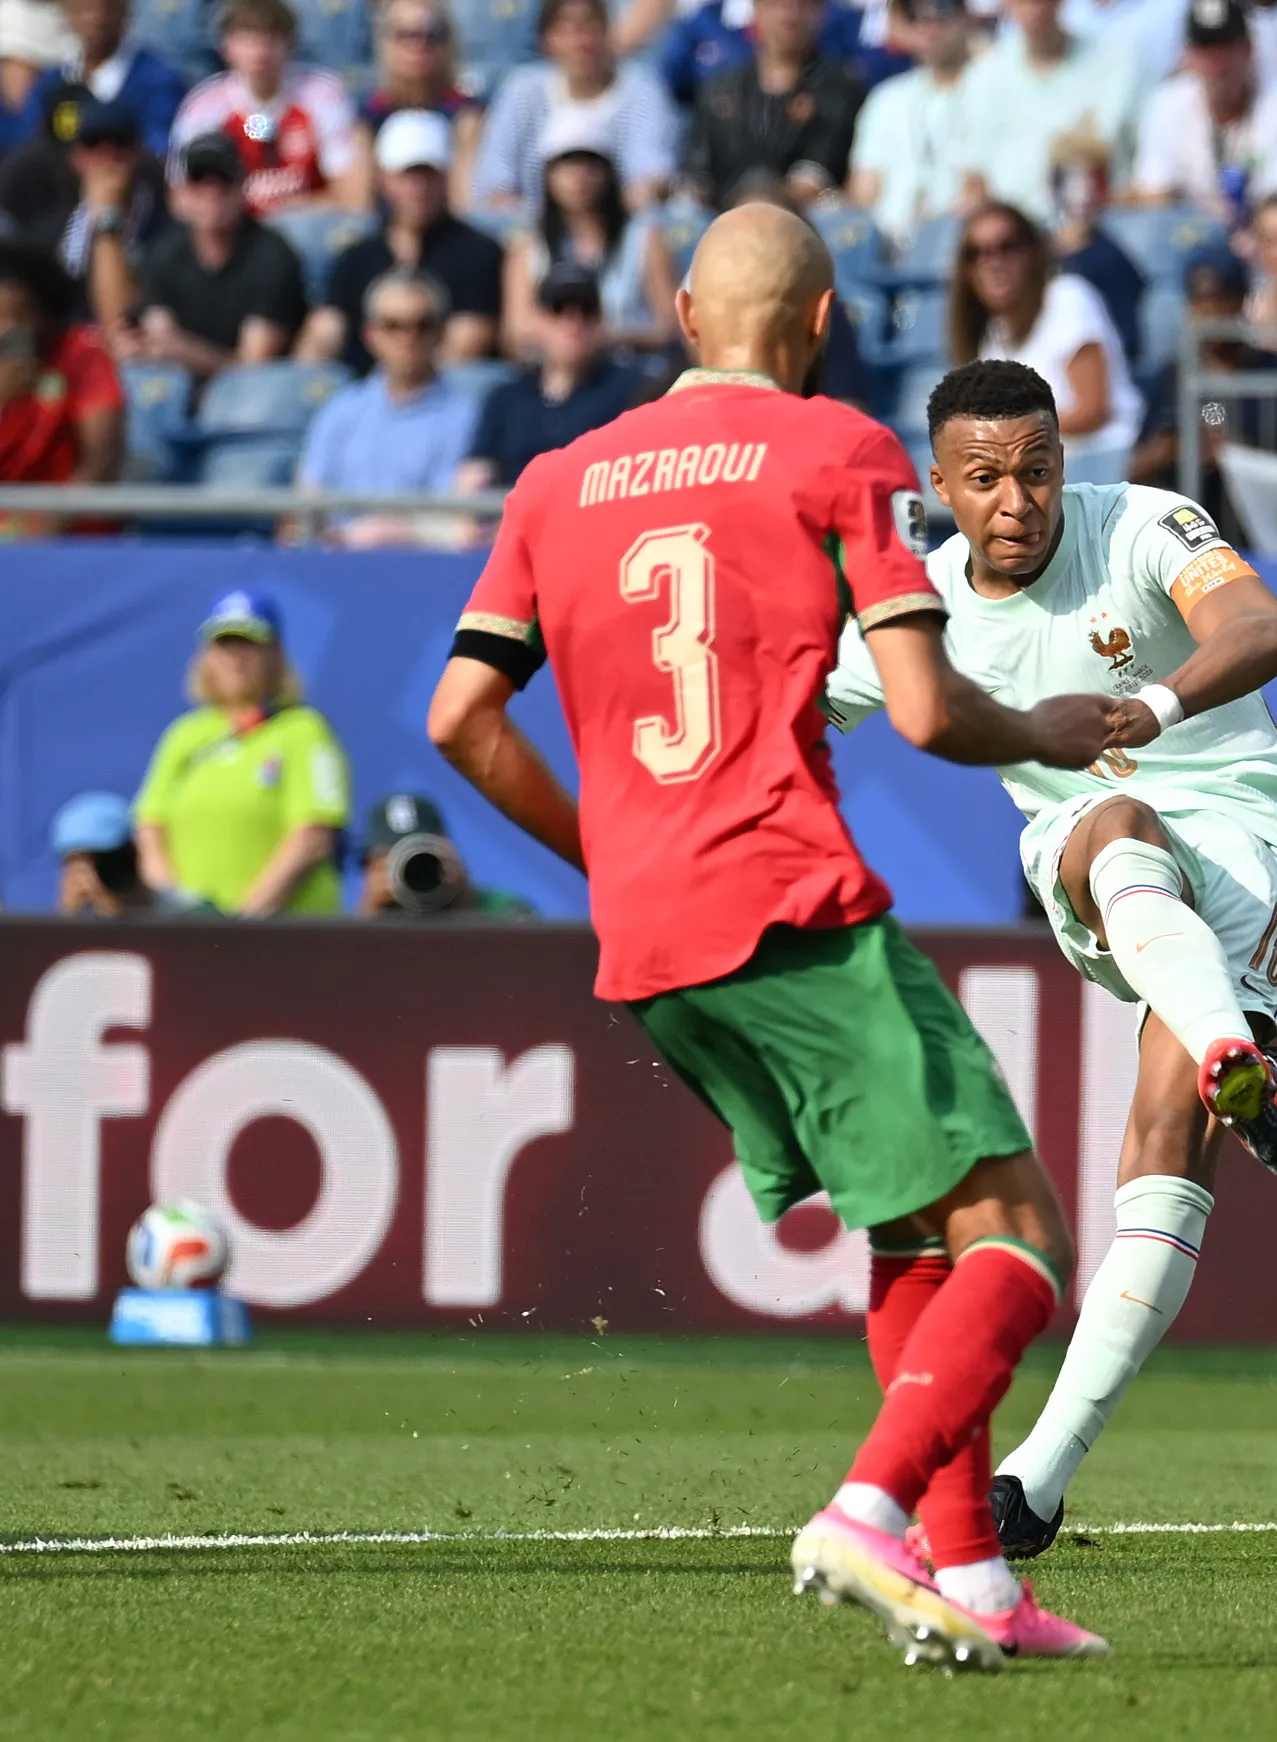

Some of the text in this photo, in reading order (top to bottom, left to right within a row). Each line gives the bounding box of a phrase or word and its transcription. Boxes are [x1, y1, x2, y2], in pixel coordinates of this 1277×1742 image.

[579, 442, 768, 508] MAZRAOUI
[619, 521, 723, 785] 3
[1180, 553, 1228, 588] UNITES
[2, 950, 577, 1308] for
